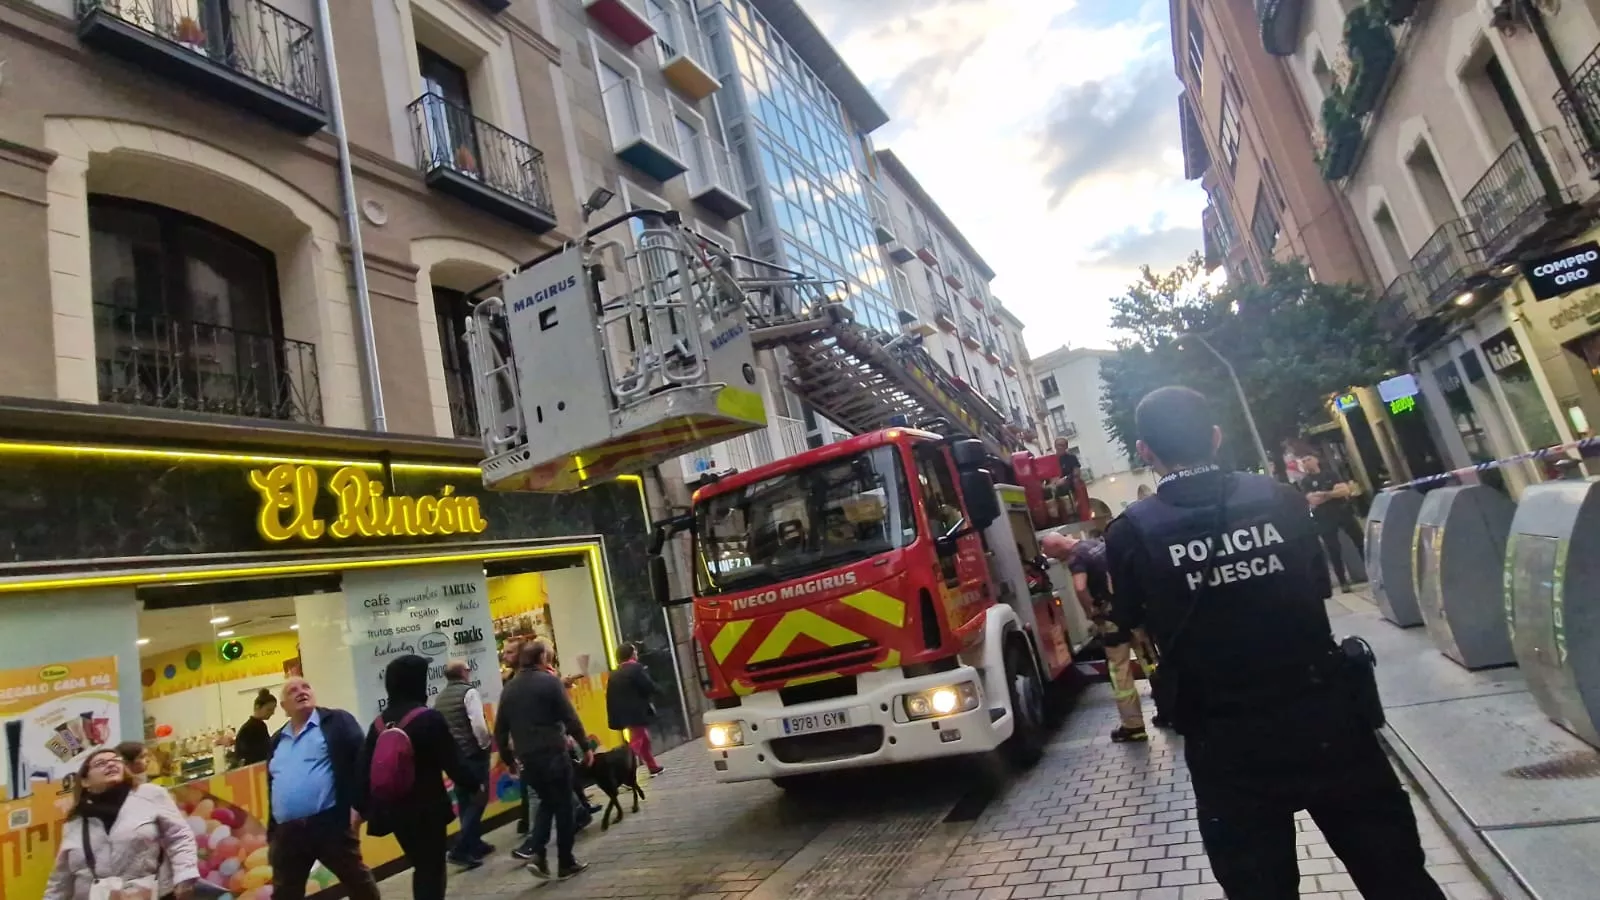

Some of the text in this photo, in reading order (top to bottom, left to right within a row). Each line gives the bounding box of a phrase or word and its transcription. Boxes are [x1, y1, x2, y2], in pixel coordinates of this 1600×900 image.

[1533, 250, 1598, 277] COMPRO
[1554, 268, 1589, 285] ORO
[513, 275, 577, 313] MAGIRUS
[250, 463, 488, 541] El Rincón
[1168, 522, 1285, 567] POLICIA
[1185, 554, 1285, 591] HUESCA
[441, 582, 476, 597] TARTAS
[733, 571, 857, 611] IVECO MAGIRUS
[363, 593, 391, 608] café
[409, 608, 440, 619] regalos
[367, 624, 421, 638] frutos secos
[453, 626, 484, 646] snacks
[791, 715, 820, 731] 9781
